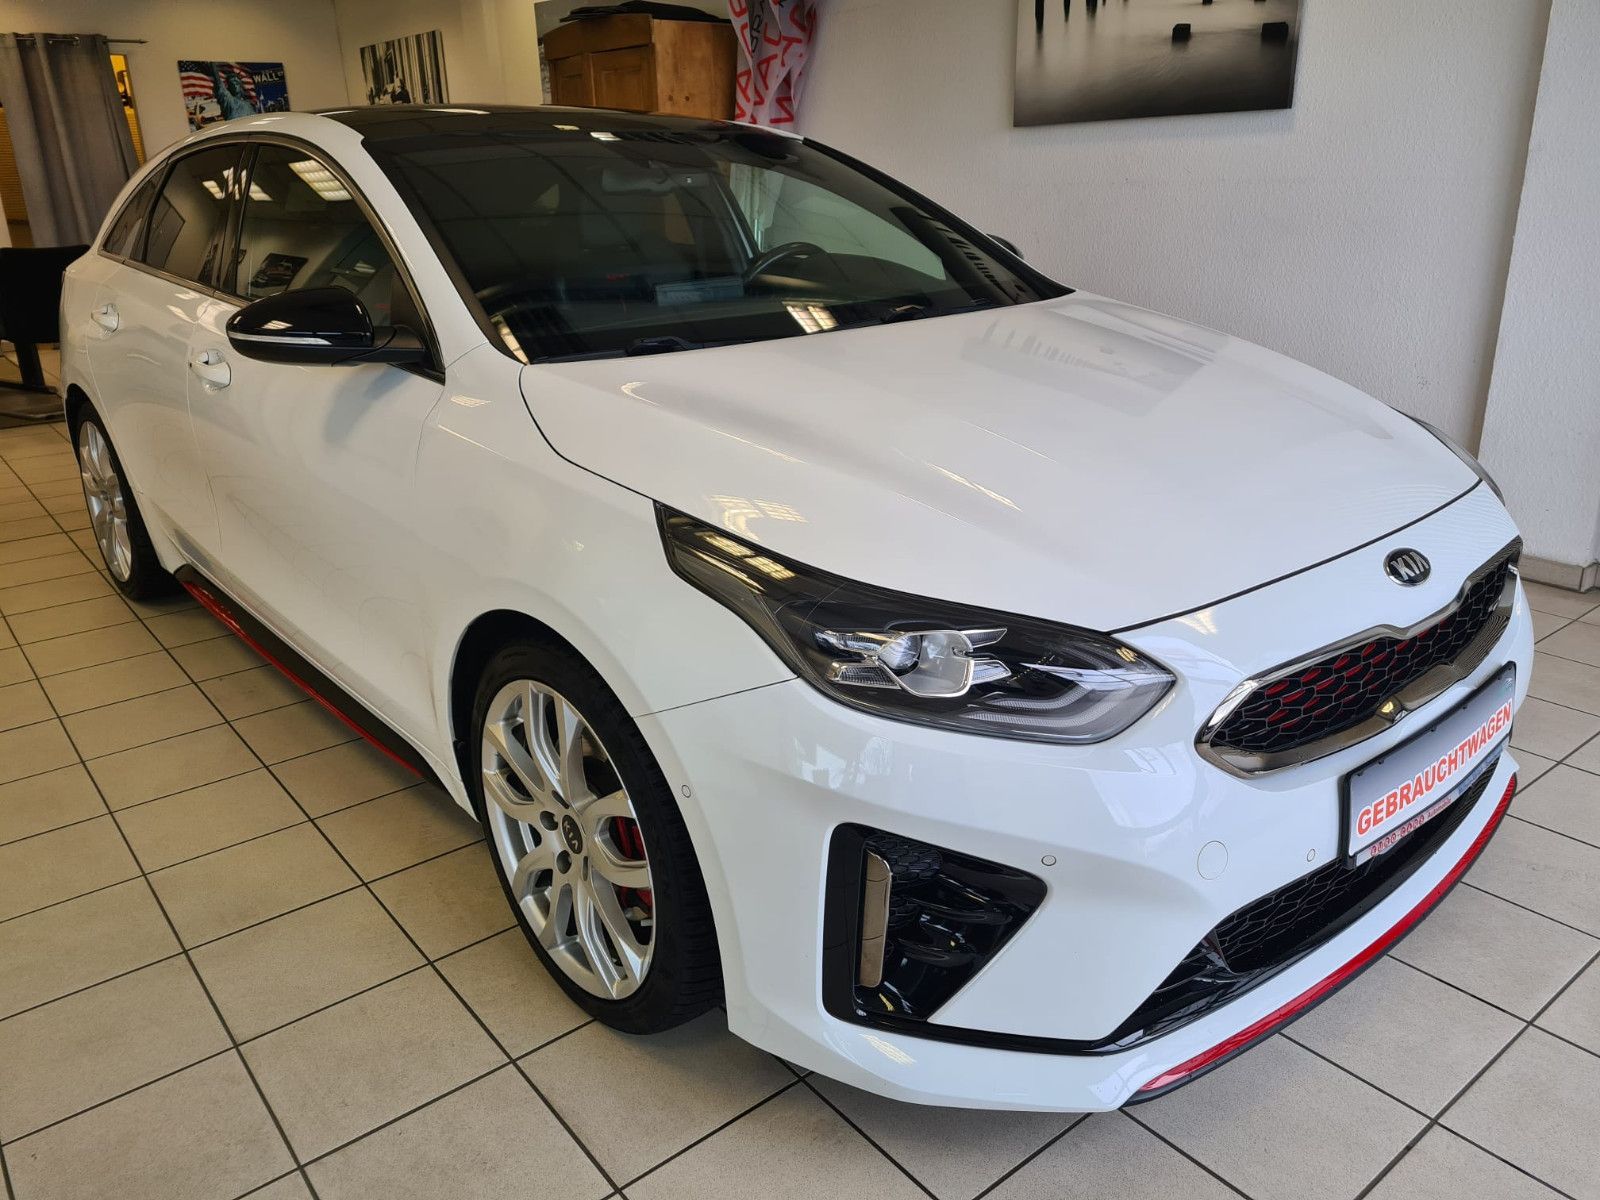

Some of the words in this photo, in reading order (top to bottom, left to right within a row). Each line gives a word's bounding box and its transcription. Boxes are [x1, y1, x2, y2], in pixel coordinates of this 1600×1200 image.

[253, 72, 279, 82] WALL
[1390, 552, 1430, 580] KIA
[1357, 701, 1511, 835] GEBRAUCHTWAGEN
[563, 820, 579, 850] KIA
